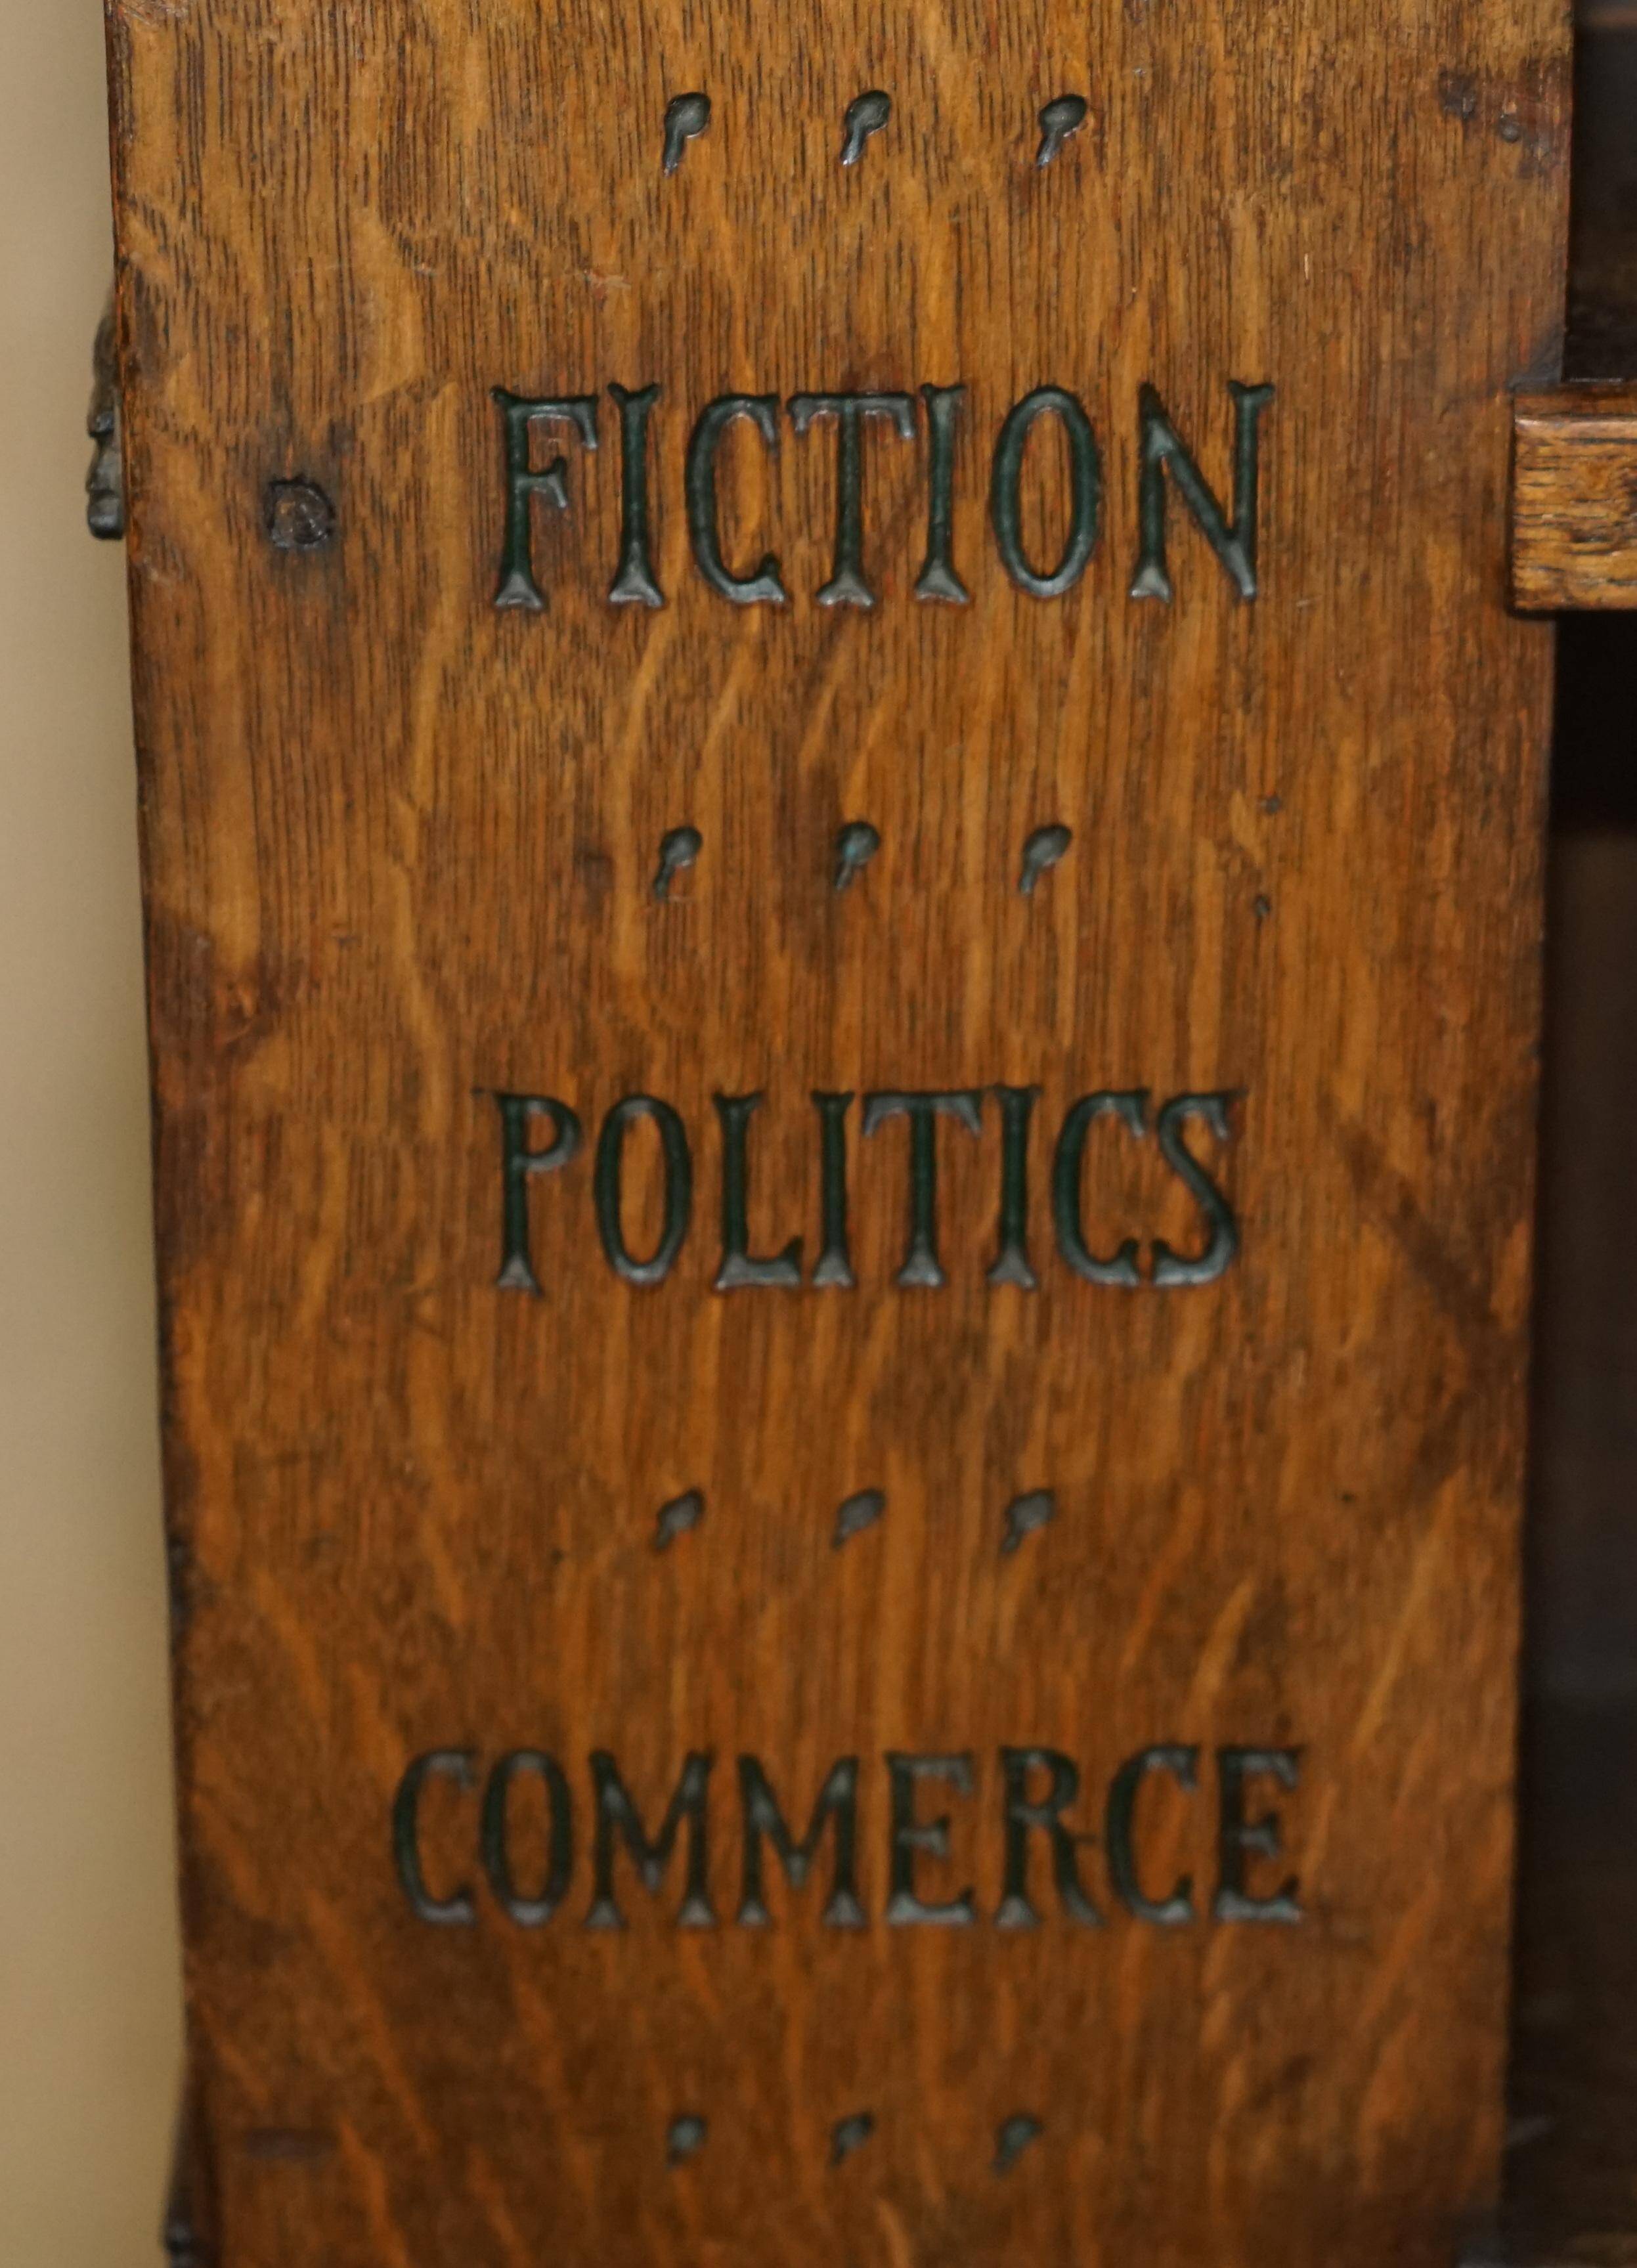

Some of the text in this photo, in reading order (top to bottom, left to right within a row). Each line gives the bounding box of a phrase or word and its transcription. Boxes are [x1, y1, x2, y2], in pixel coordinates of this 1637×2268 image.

[492, 383, 1275, 611] FICTION
[473, 1084, 1244, 1298] POLITICS
[395, 1745, 1305, 1929] COMMERCE
